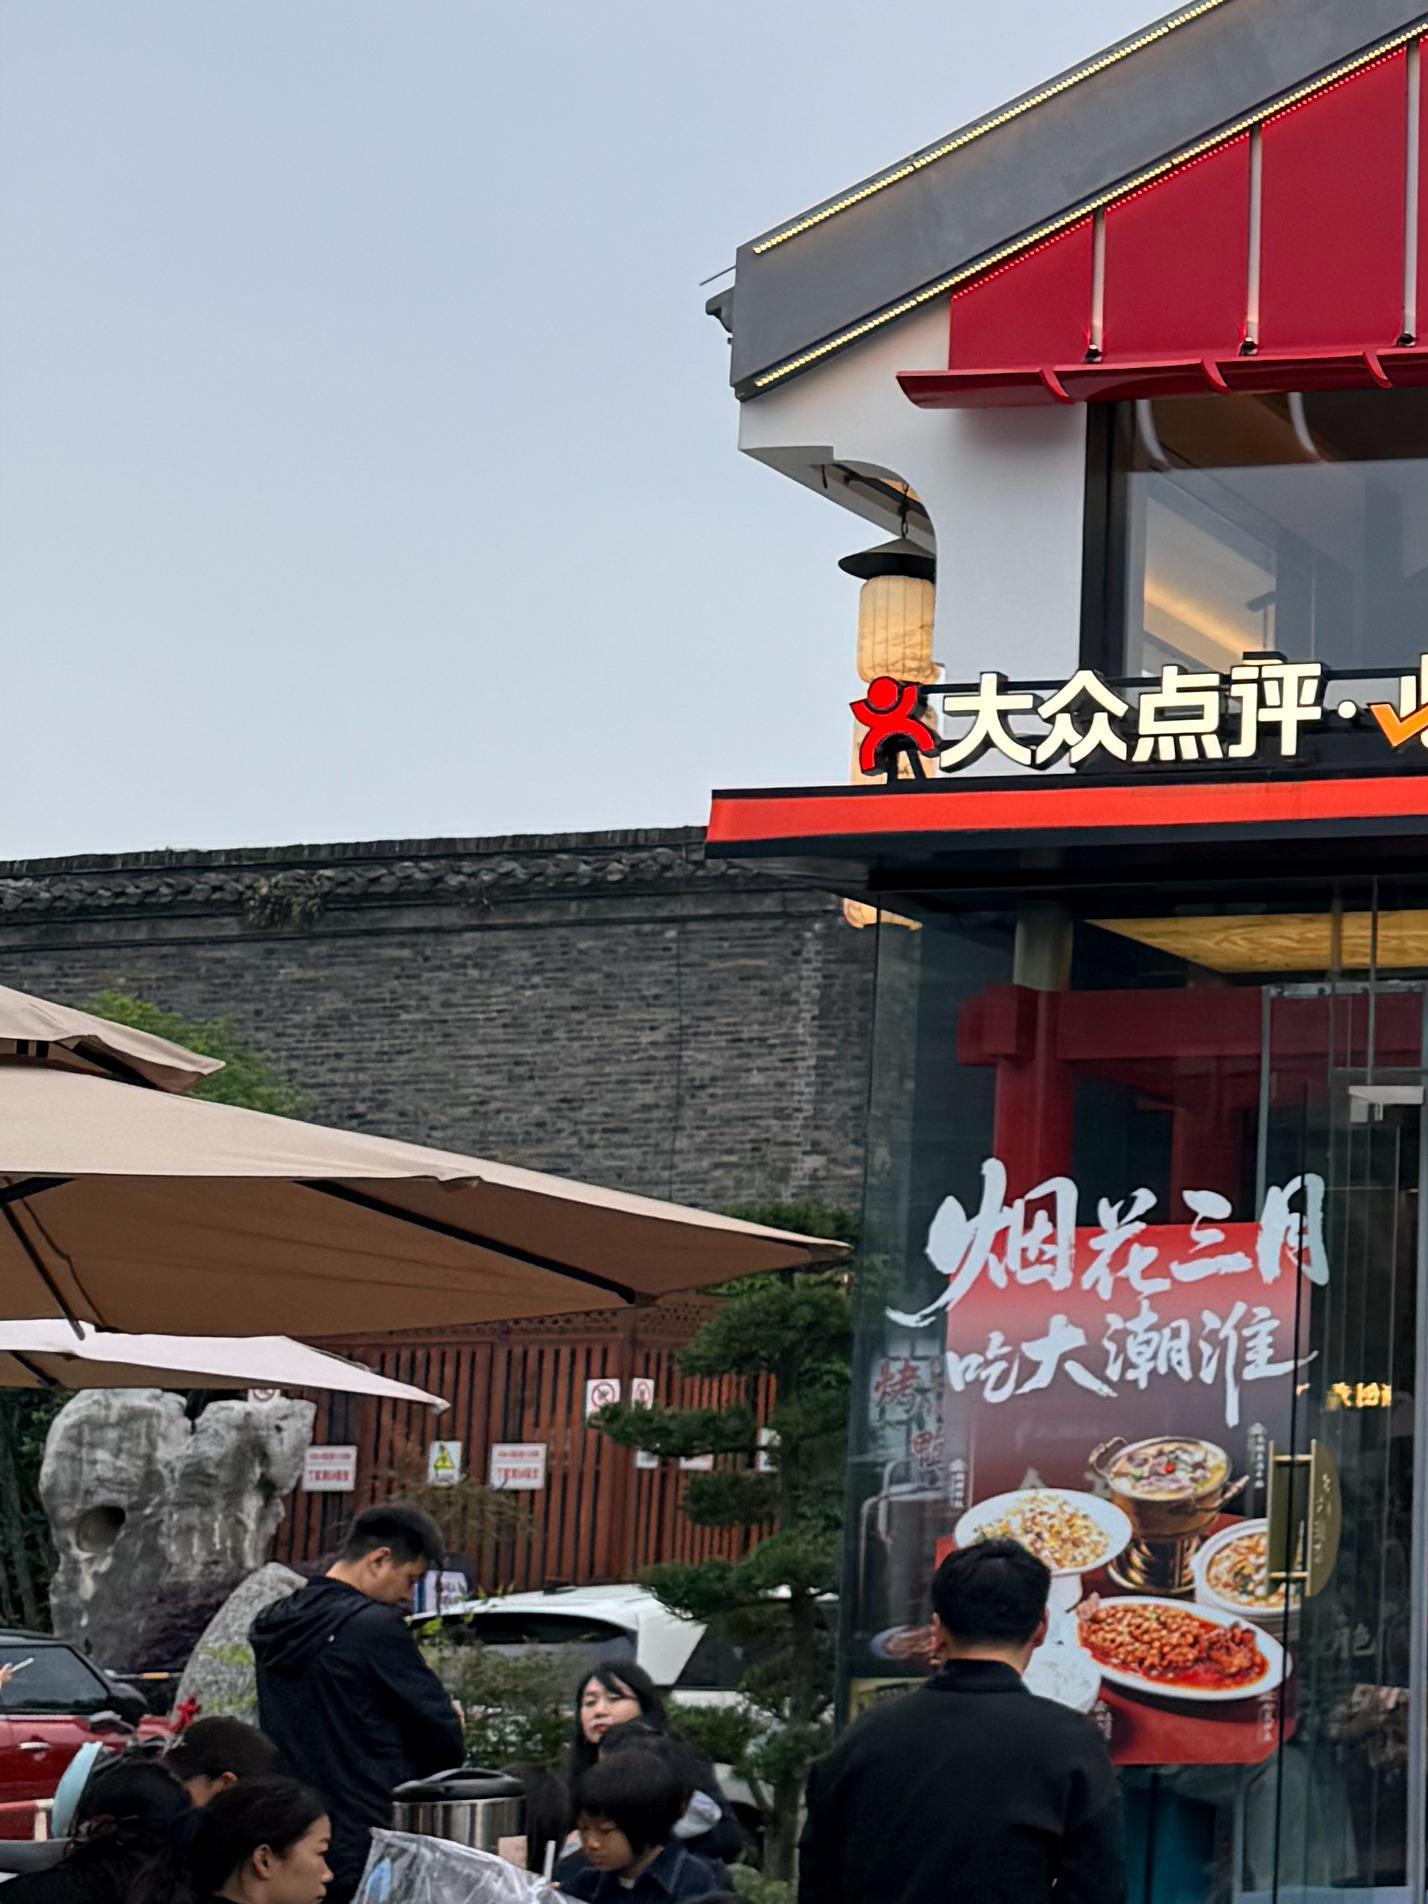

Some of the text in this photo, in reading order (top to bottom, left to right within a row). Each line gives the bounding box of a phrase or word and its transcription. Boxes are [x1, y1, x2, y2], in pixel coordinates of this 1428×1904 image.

[886, 1157, 1329, 1328] 烟花三月
[947, 1300, 1319, 1427] 吃大潮淮
